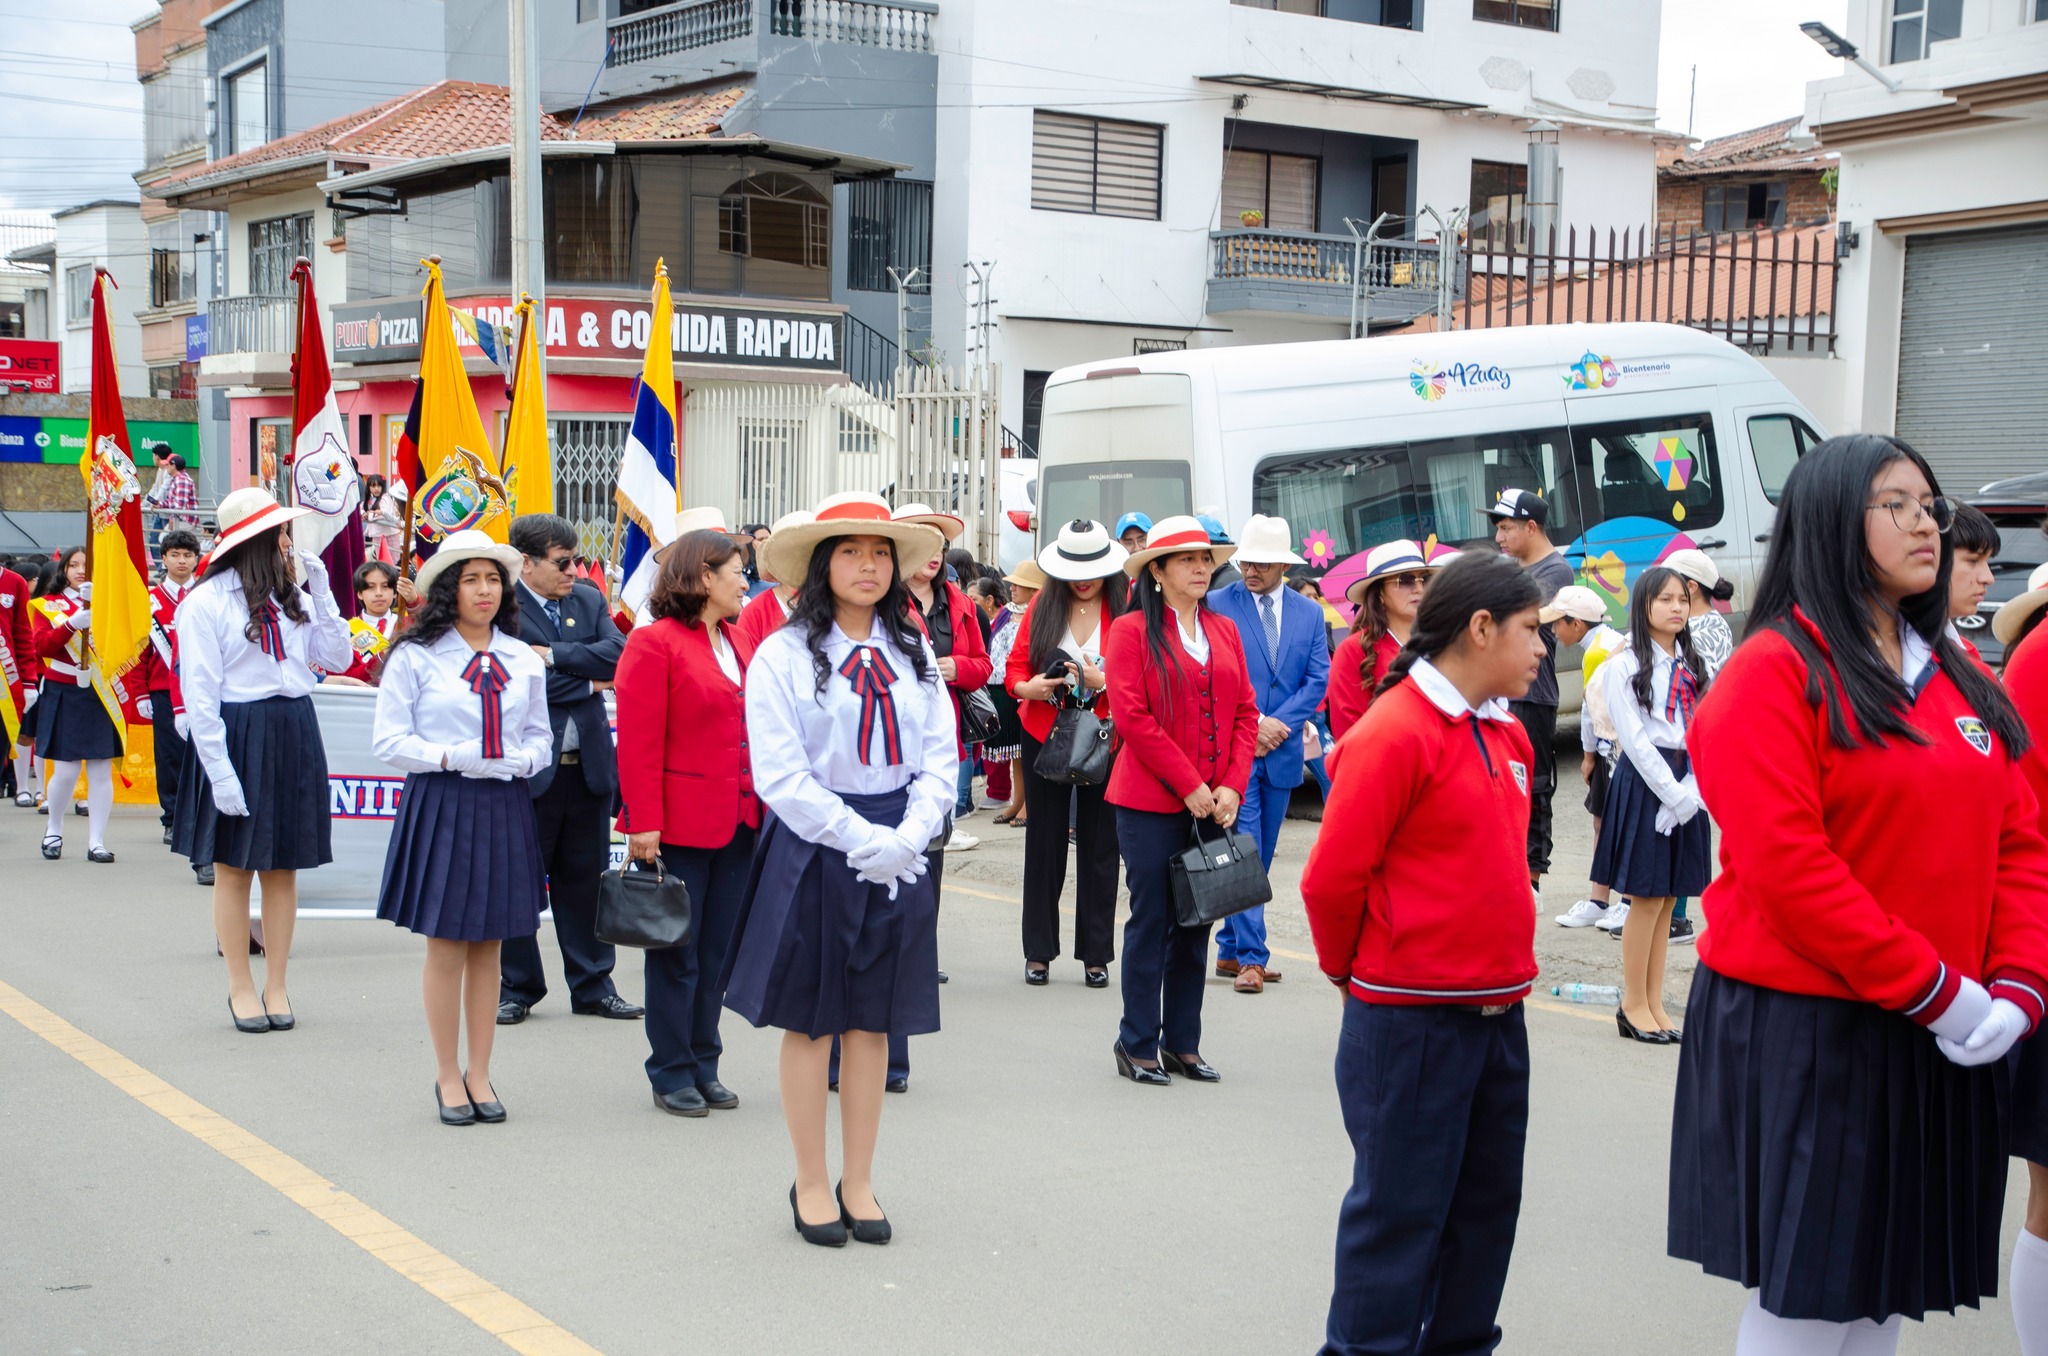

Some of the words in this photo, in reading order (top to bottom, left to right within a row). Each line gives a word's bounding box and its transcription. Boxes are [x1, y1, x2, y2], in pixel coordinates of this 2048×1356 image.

[381, 317, 418, 345] PIZZA
[577, 311, 600, 347] &
[737, 317, 834, 361] RAPIDA
[1623, 362, 1671, 374] Bicentenario
[0, 432, 24, 446] ianza
[300, 485, 320, 507] BAÑOS
